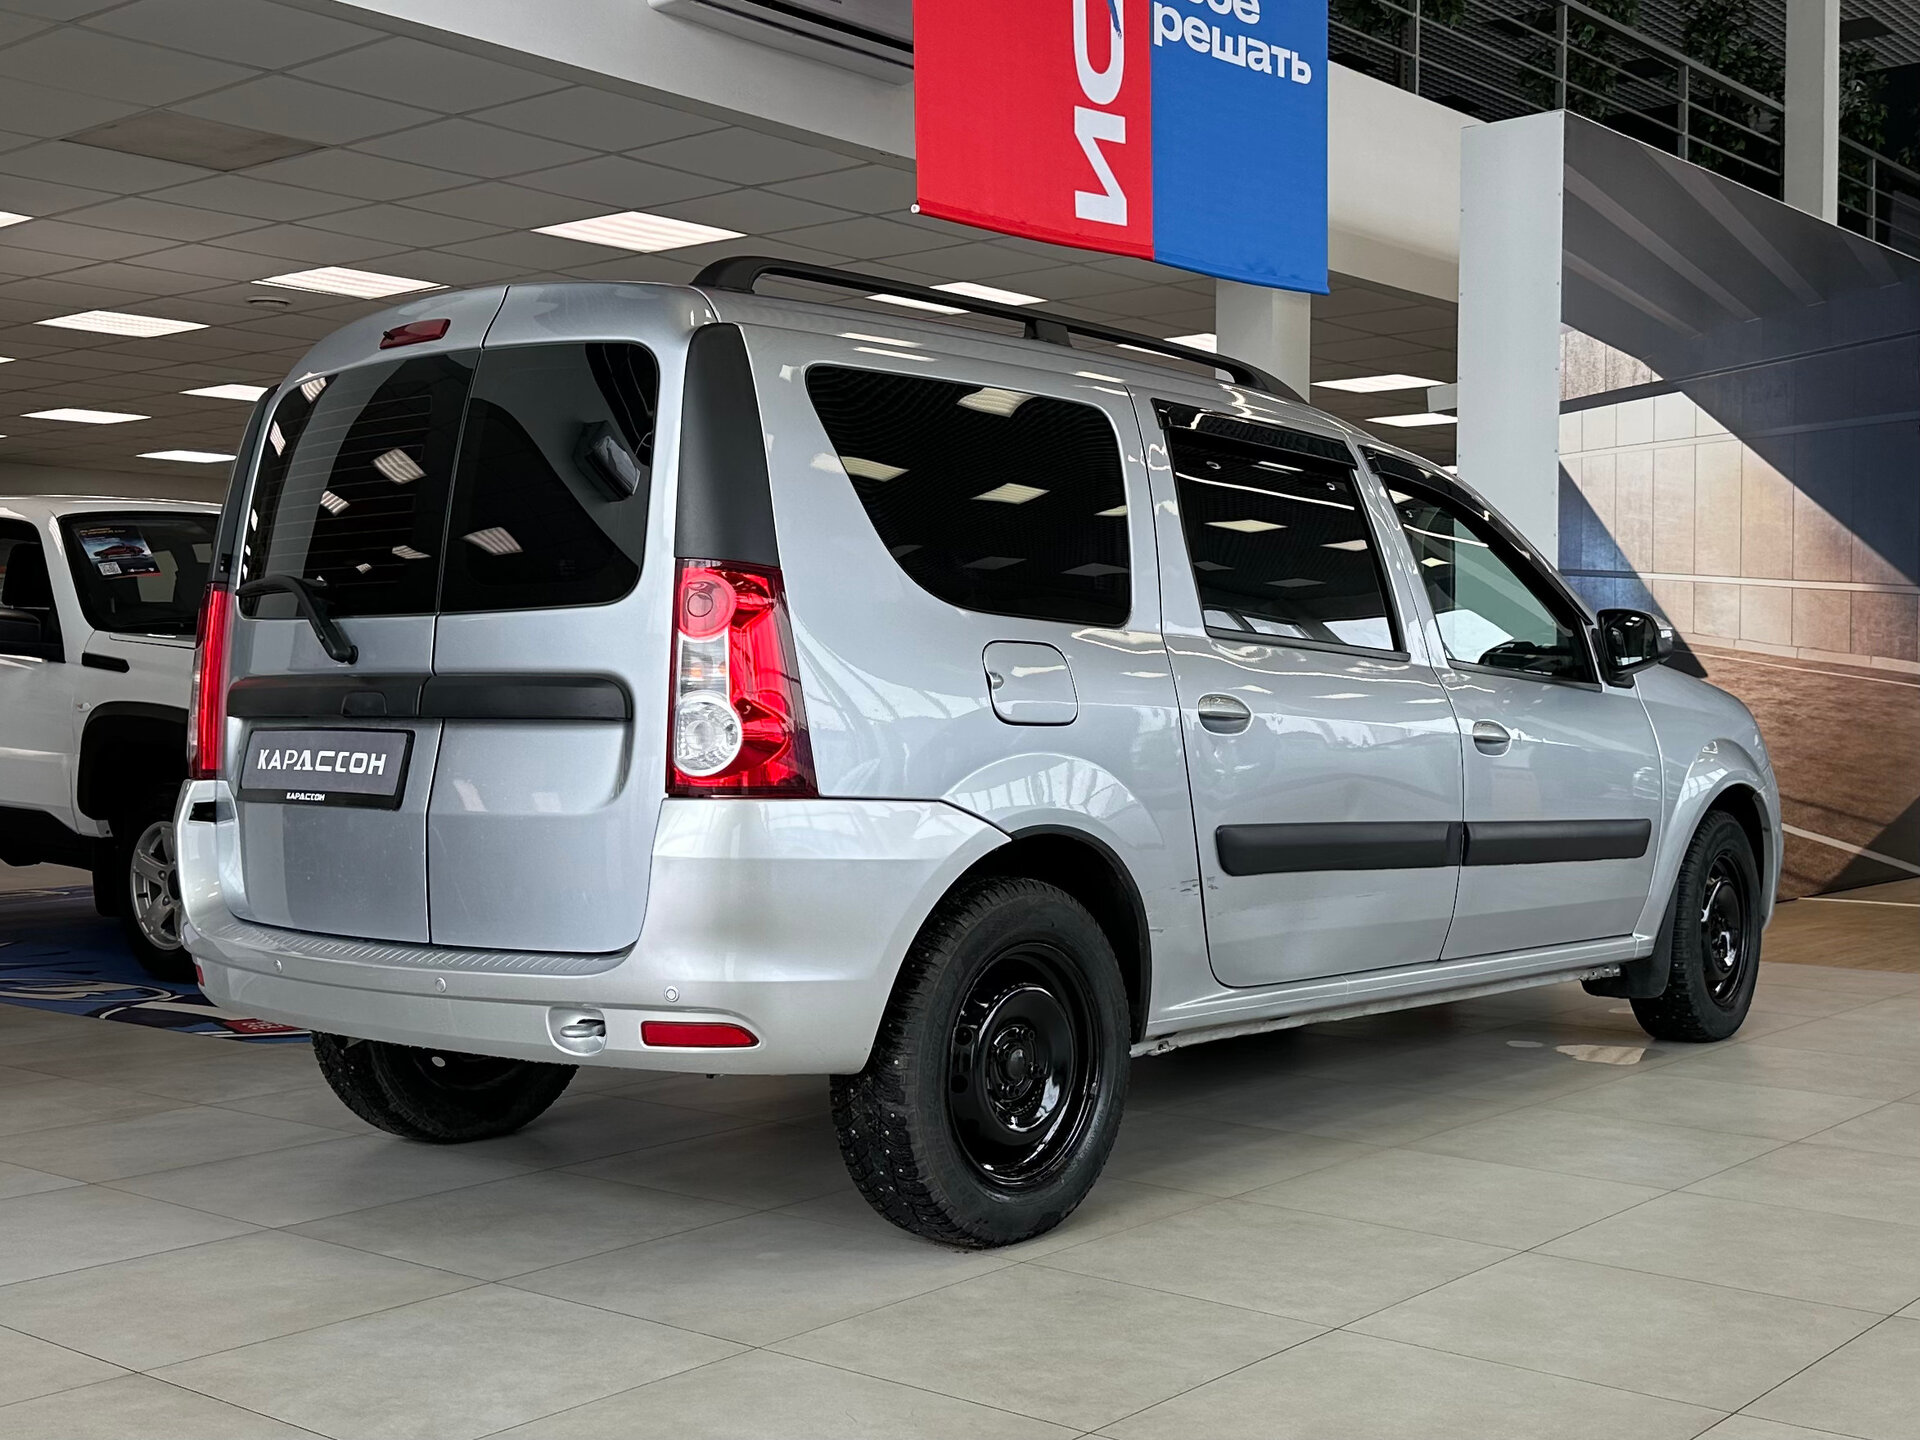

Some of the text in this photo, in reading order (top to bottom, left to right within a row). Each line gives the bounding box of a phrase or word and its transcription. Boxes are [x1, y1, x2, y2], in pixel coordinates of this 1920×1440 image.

[1153, 2, 1312, 85] решать
[257, 749, 387, 775] КАРАССОН
[286, 792, 325, 801] КАРАССОН
